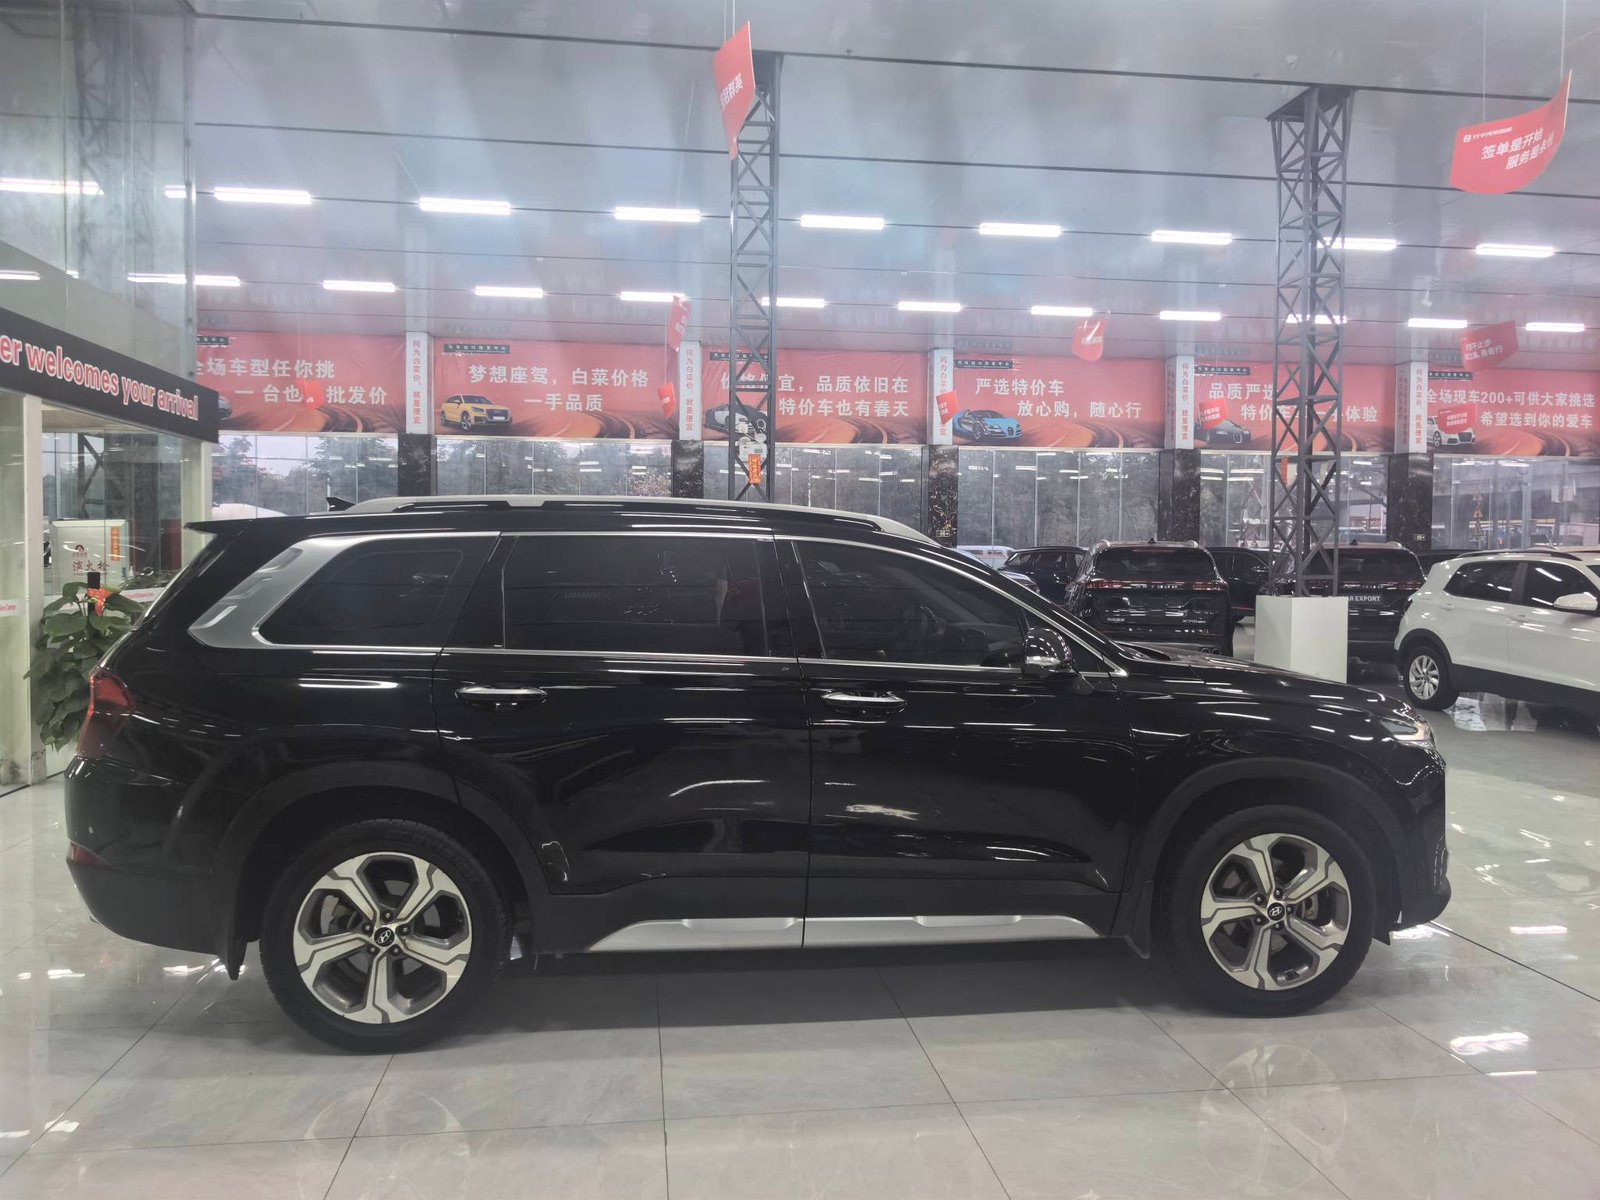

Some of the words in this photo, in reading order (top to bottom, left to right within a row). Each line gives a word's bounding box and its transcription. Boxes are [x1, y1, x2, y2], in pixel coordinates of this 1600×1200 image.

[1481, 127, 1544, 160] 签单是开始
[25, 343, 119, 396] welcomes
[122, 376, 156, 405] your
[157, 389, 199, 421] arrival
[468, 365, 649, 388] 梦想座驾，白菜价格
[235, 384, 387, 405] 一台也批发价
[975, 378, 1065, 396] 严选特价车
[524, 393, 603, 411] 一手品质
[779, 398, 909, 417] 特价车也有春天
[1427, 388, 1595, 408] 全场现车200+可供大家挑选
[1017, 401, 1141, 419] 放心购，随心行
[1480, 411, 1593, 429] 希望选到你的爱车
[73, 560, 109, 571] 消火栓
